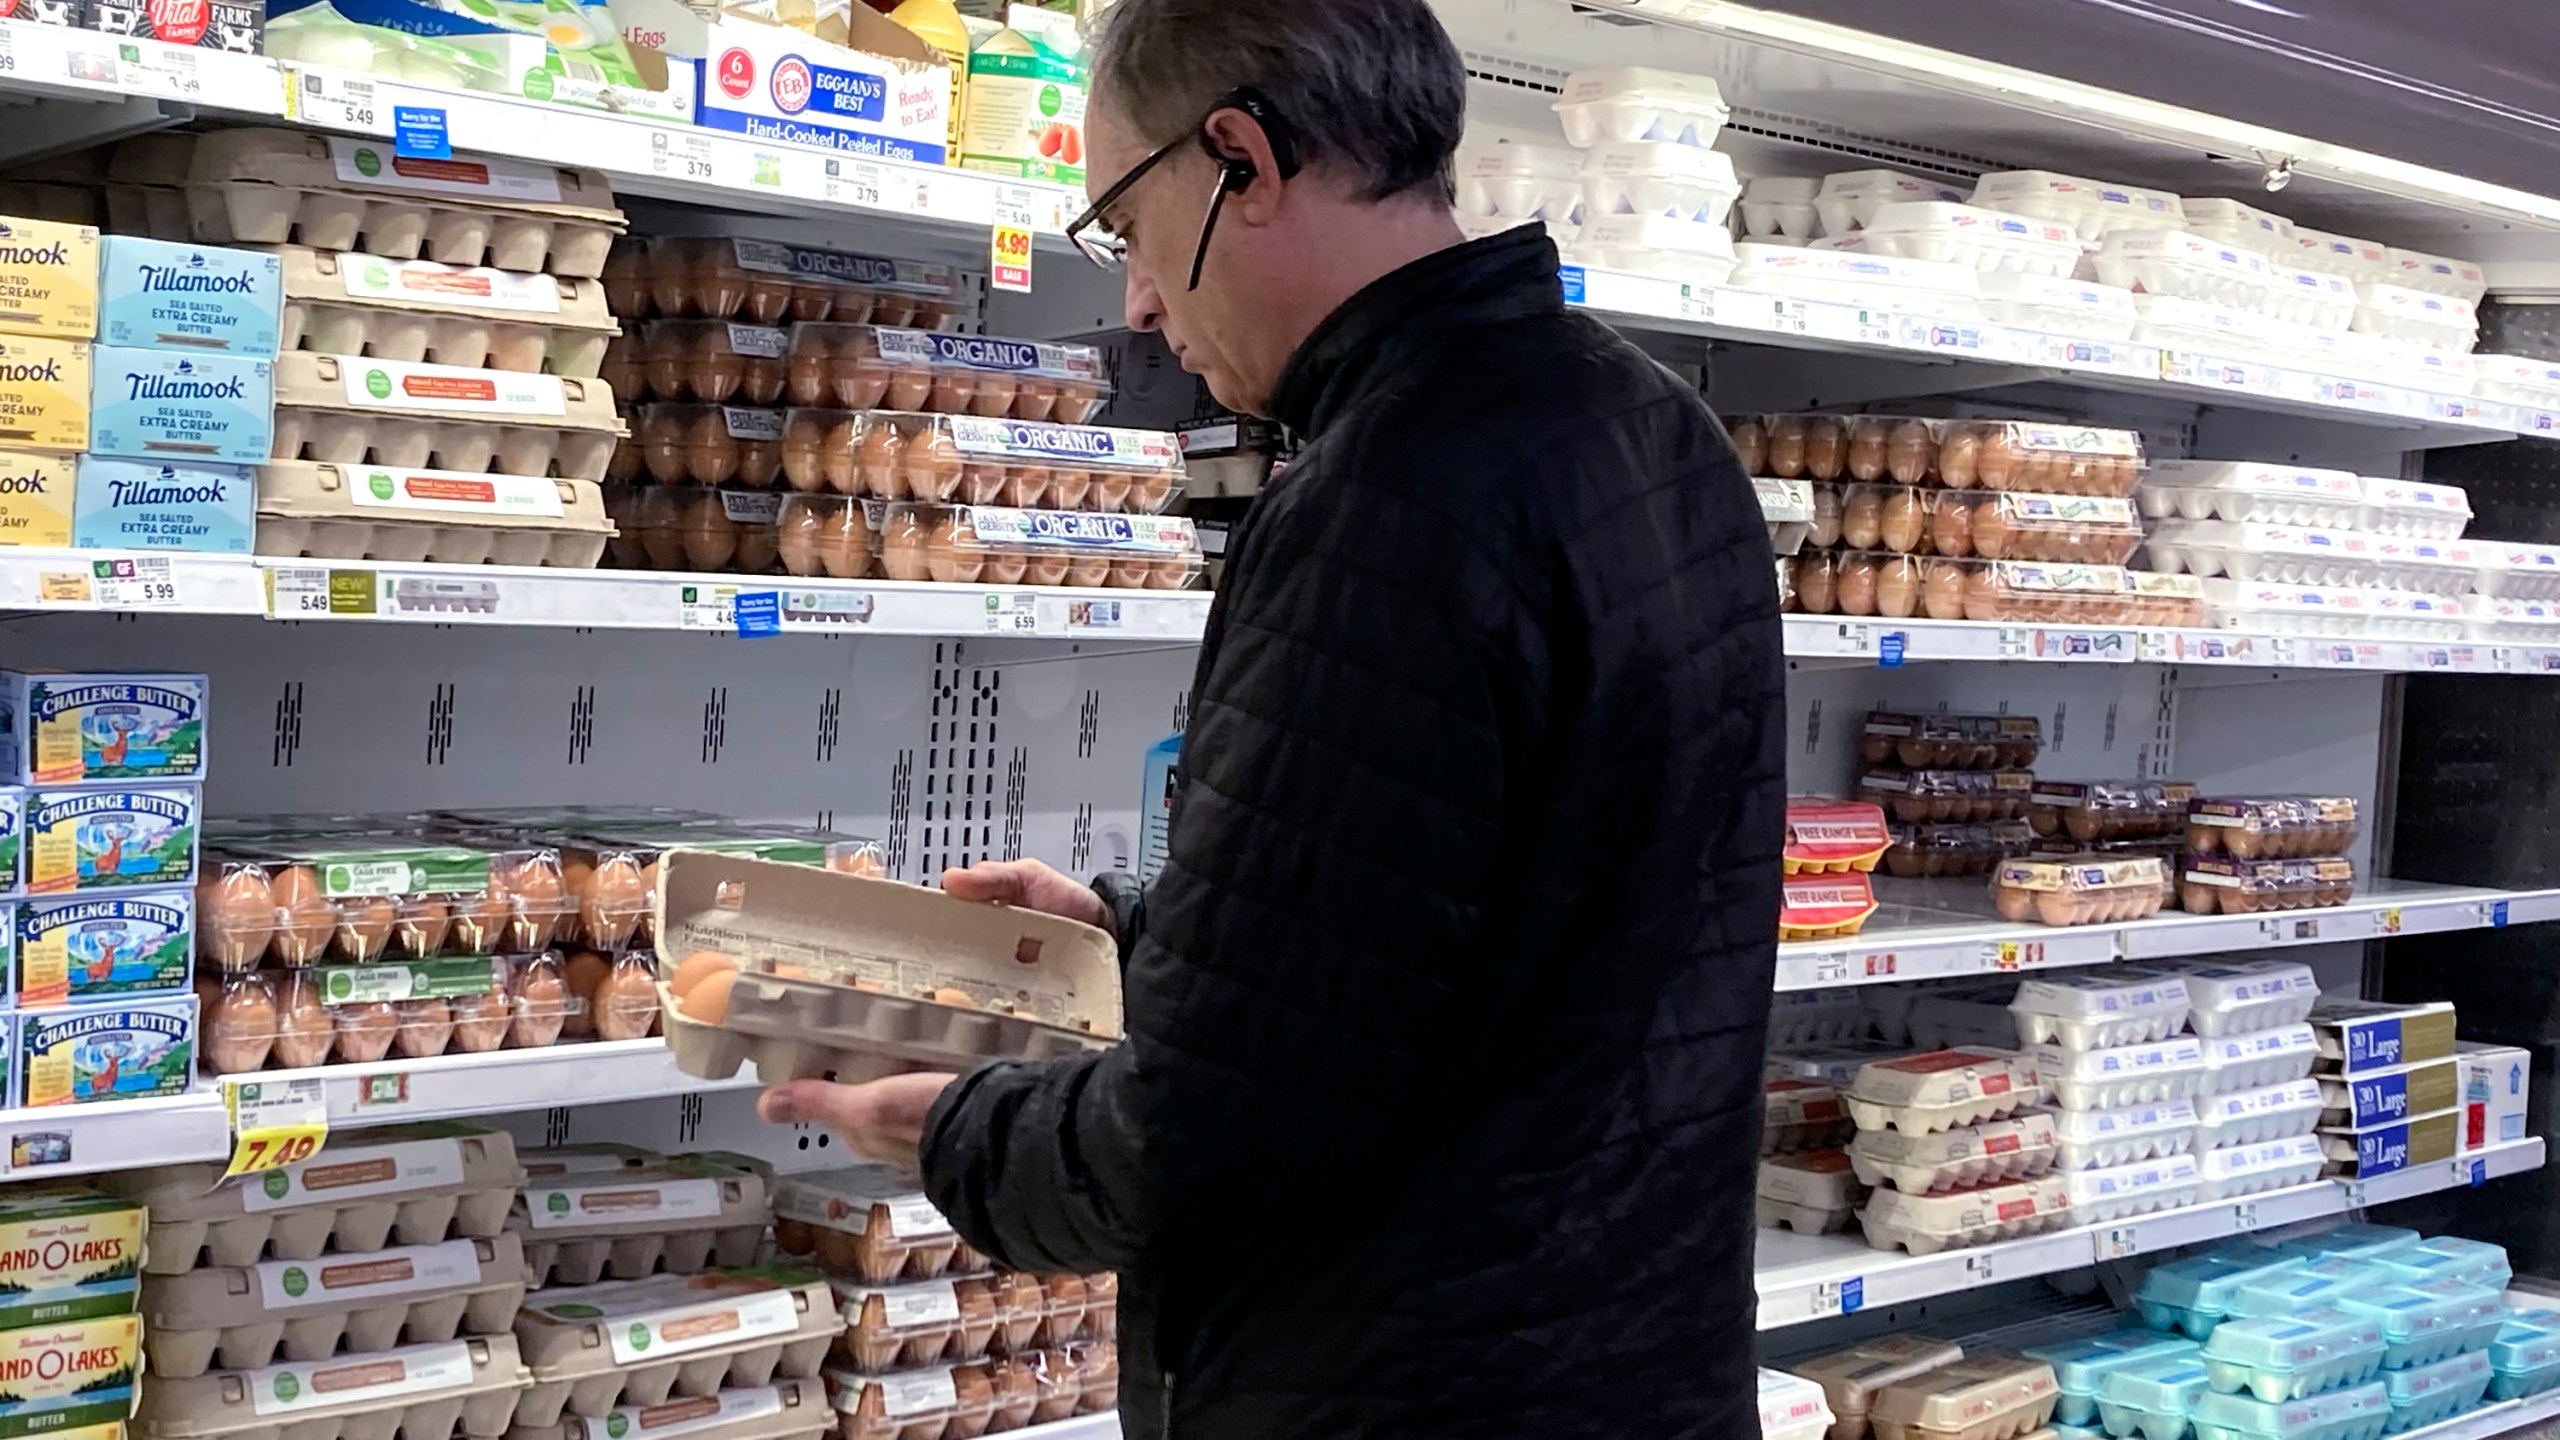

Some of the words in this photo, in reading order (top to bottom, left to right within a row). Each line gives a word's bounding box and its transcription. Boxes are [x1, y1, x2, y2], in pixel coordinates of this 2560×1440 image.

[150, 0, 200, 26] Vital
[211, 4, 253, 27] FARMS
[165, 27, 197, 38] FARMS
[634, 27, 666, 48] Eggs
[731, 55, 743, 74] 6
[721, 74, 750, 89] Count
[782, 78, 803, 95] EB
[833, 92, 865, 113] BEST
[898, 86, 934, 108] Ready
[345, 108, 374, 125] 5.49
[901, 113, 914, 127] to
[916, 104, 939, 123] Eat!
[746, 117, 835, 147] Hard-Cooked
[838, 132, 881, 155] Peeled
[884, 143, 914, 161] Eggs
[687, 161, 712, 177] 3.79
[857, 187, 879, 203] 3.79
[1012, 211, 1031, 225] 5.49
[995, 231, 1030, 256] 4.99
[797, 251, 892, 282] ORGANIC
[1001, 268, 1023, 282] SALE
[138, 264, 255, 294] Tillamook
[168, 300, 189, 310] SEA
[190, 302, 223, 314] SALTED
[151, 308, 188, 323] EXTRA
[190, 312, 239, 328] CREAMY
[176, 322, 212, 336] BUTTER
[939, 338, 1033, 366] ORGANIC
[125, 373, 244, 401] Tillamook
[157, 407, 177, 417] SEA
[179, 408, 213, 420] SALTED
[139, 416, 177, 429] EXTRA
[180, 418, 229, 433] CREAMY
[165, 430, 202, 441] BUTTER
[1014, 427, 1108, 453] ORGANIC
[108, 478, 227, 509] Tillamook
[139, 513, 156, 523] SEA
[159, 513, 194, 524] SALTED
[1034, 513, 1127, 539] ORGANIC
[121, 522, 157, 535] EXTRA
[160, 524, 210, 536] CREAMY
[146, 536, 183, 546] BUTTER
[116, 562, 132, 576] GF
[144, 583, 174, 599] 5.99
[331, 577, 369, 590] NEW!
[301, 595, 328, 610] 5.49
[1015, 616, 1035, 629] 6.59
[42, 685, 131, 715] CHALLENGE
[137, 685, 190, 714] BUTTER
[38, 794, 126, 824] CHALLENGE
[131, 794, 184, 822] BUTTER
[1799, 827, 1821, 839] FREE
[1822, 827, 1852, 839] RANGE
[353, 867, 375, 876] CAGE
[377, 866, 397, 875] FREE
[1788, 891, 1809, 903] FREE
[1810, 891, 1840, 902] RANGE
[28, 902, 118, 935] CHALLENGE
[123, 902, 178, 928] BUTTER
[683, 933, 721, 948] Facts
[684, 922, 745, 942] Nutrition
[354, 972, 376, 981] CAGE
[377, 971, 398, 980] FREE
[35, 1012, 123, 1049] CHALLENGE
[129, 1012, 182, 1035] BUTTER
[2351, 1031, 2366, 1049] 30
[2368, 1031, 2400, 1063] Large
[2359, 1087, 2374, 1104] 30
[2375, 1085, 2406, 1116] Large
[242, 1136, 316, 1171] 7.49
[2362, 1138, 2376, 1155] 30
[2377, 1137, 2406, 1168] Large
[43, 1240, 70, 1271] O
[73, 1238, 123, 1264] LAKES
[32, 1305, 70, 1319] BUTTER
[37, 1349, 65, 1380] O
[68, 1347, 119, 1373] LAKES
[1790, 1404, 1813, 1417] GRADE
[28, 1413, 66, 1429] BUTTER
